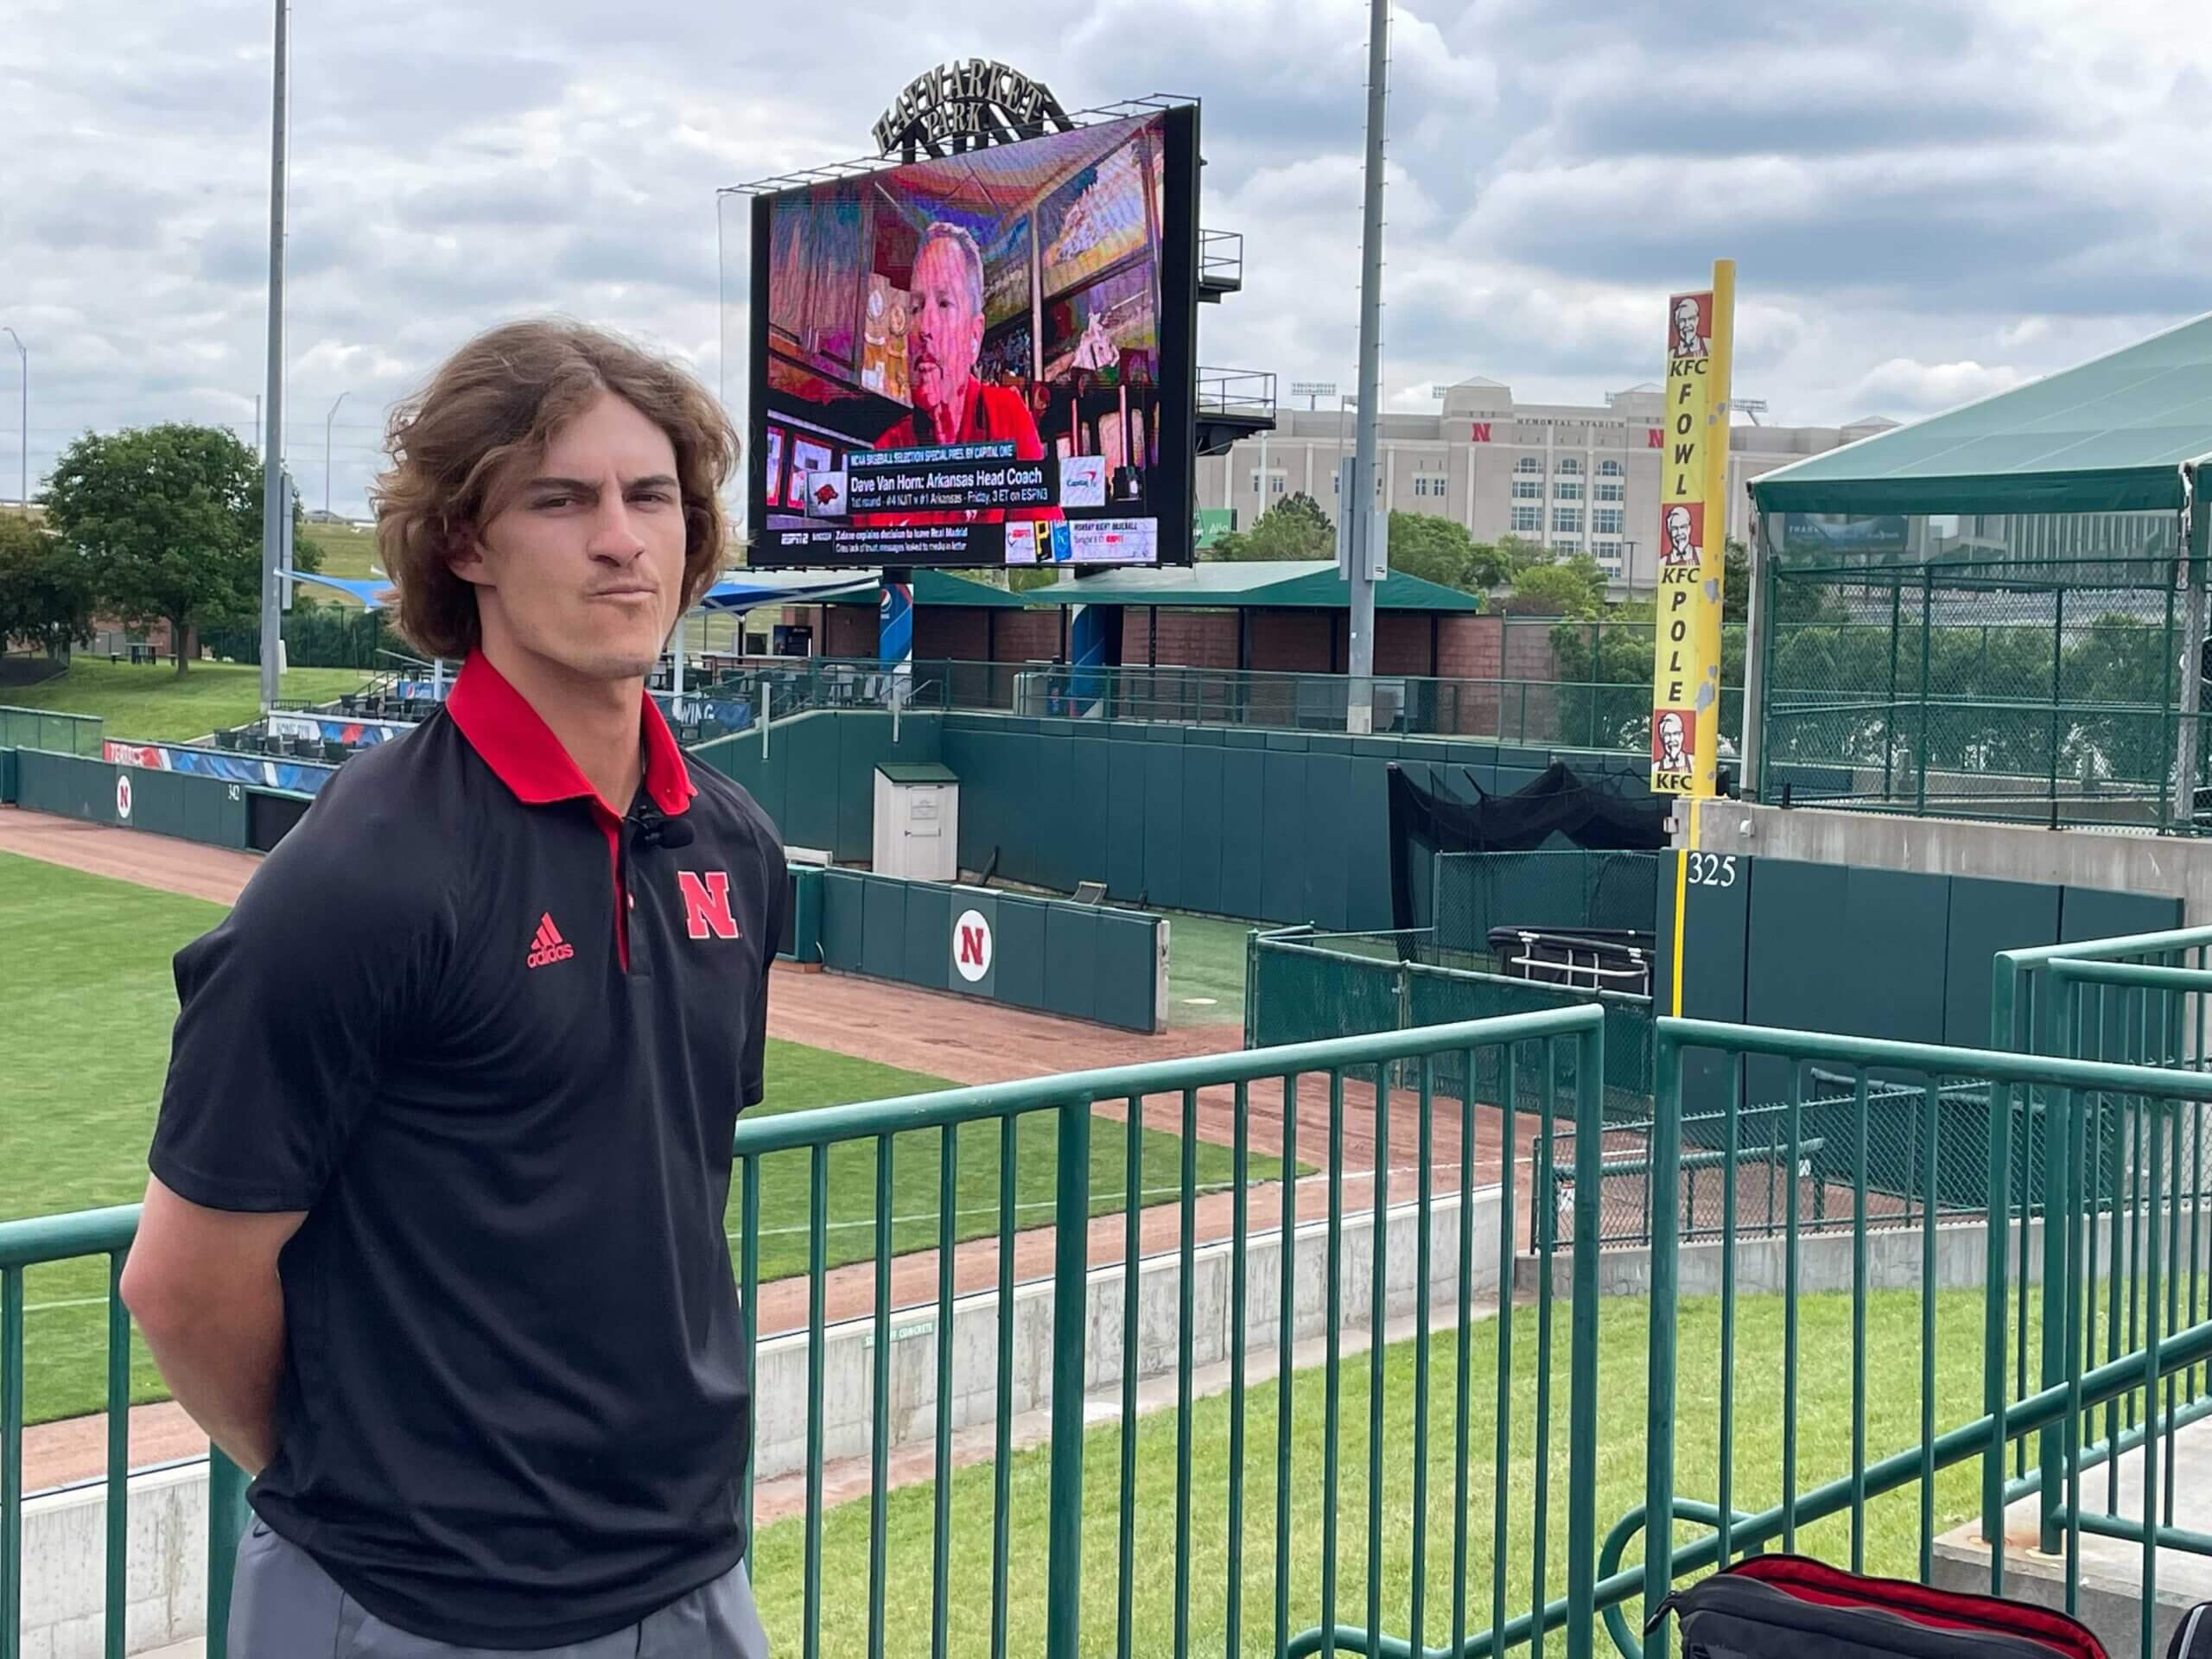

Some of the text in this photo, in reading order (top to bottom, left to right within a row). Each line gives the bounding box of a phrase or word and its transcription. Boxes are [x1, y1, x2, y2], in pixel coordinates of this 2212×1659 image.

[871, 58, 1043, 156] HAYMARKET
[925, 102, 983, 142] PARK
[1669, 359, 1708, 378] KFC
[1471, 423, 1491, 442] N
[1675, 383, 1694, 495] FOWL
[851, 467, 1042, 493] Dave Van Horn: Arkansas Head Coach
[999, 489, 1009, 501] ET
[1010, 491, 1020, 502] on
[1661, 568, 1700, 583] KFC
[1669, 591, 1687, 702] POLE
[1656, 773, 1692, 790] KFC
[120, 785, 129, 808] N
[1688, 853, 1736, 887] 325
[677, 871, 739, 939] N
[527, 944, 574, 968] adidas
[961, 925, 984, 966] N
